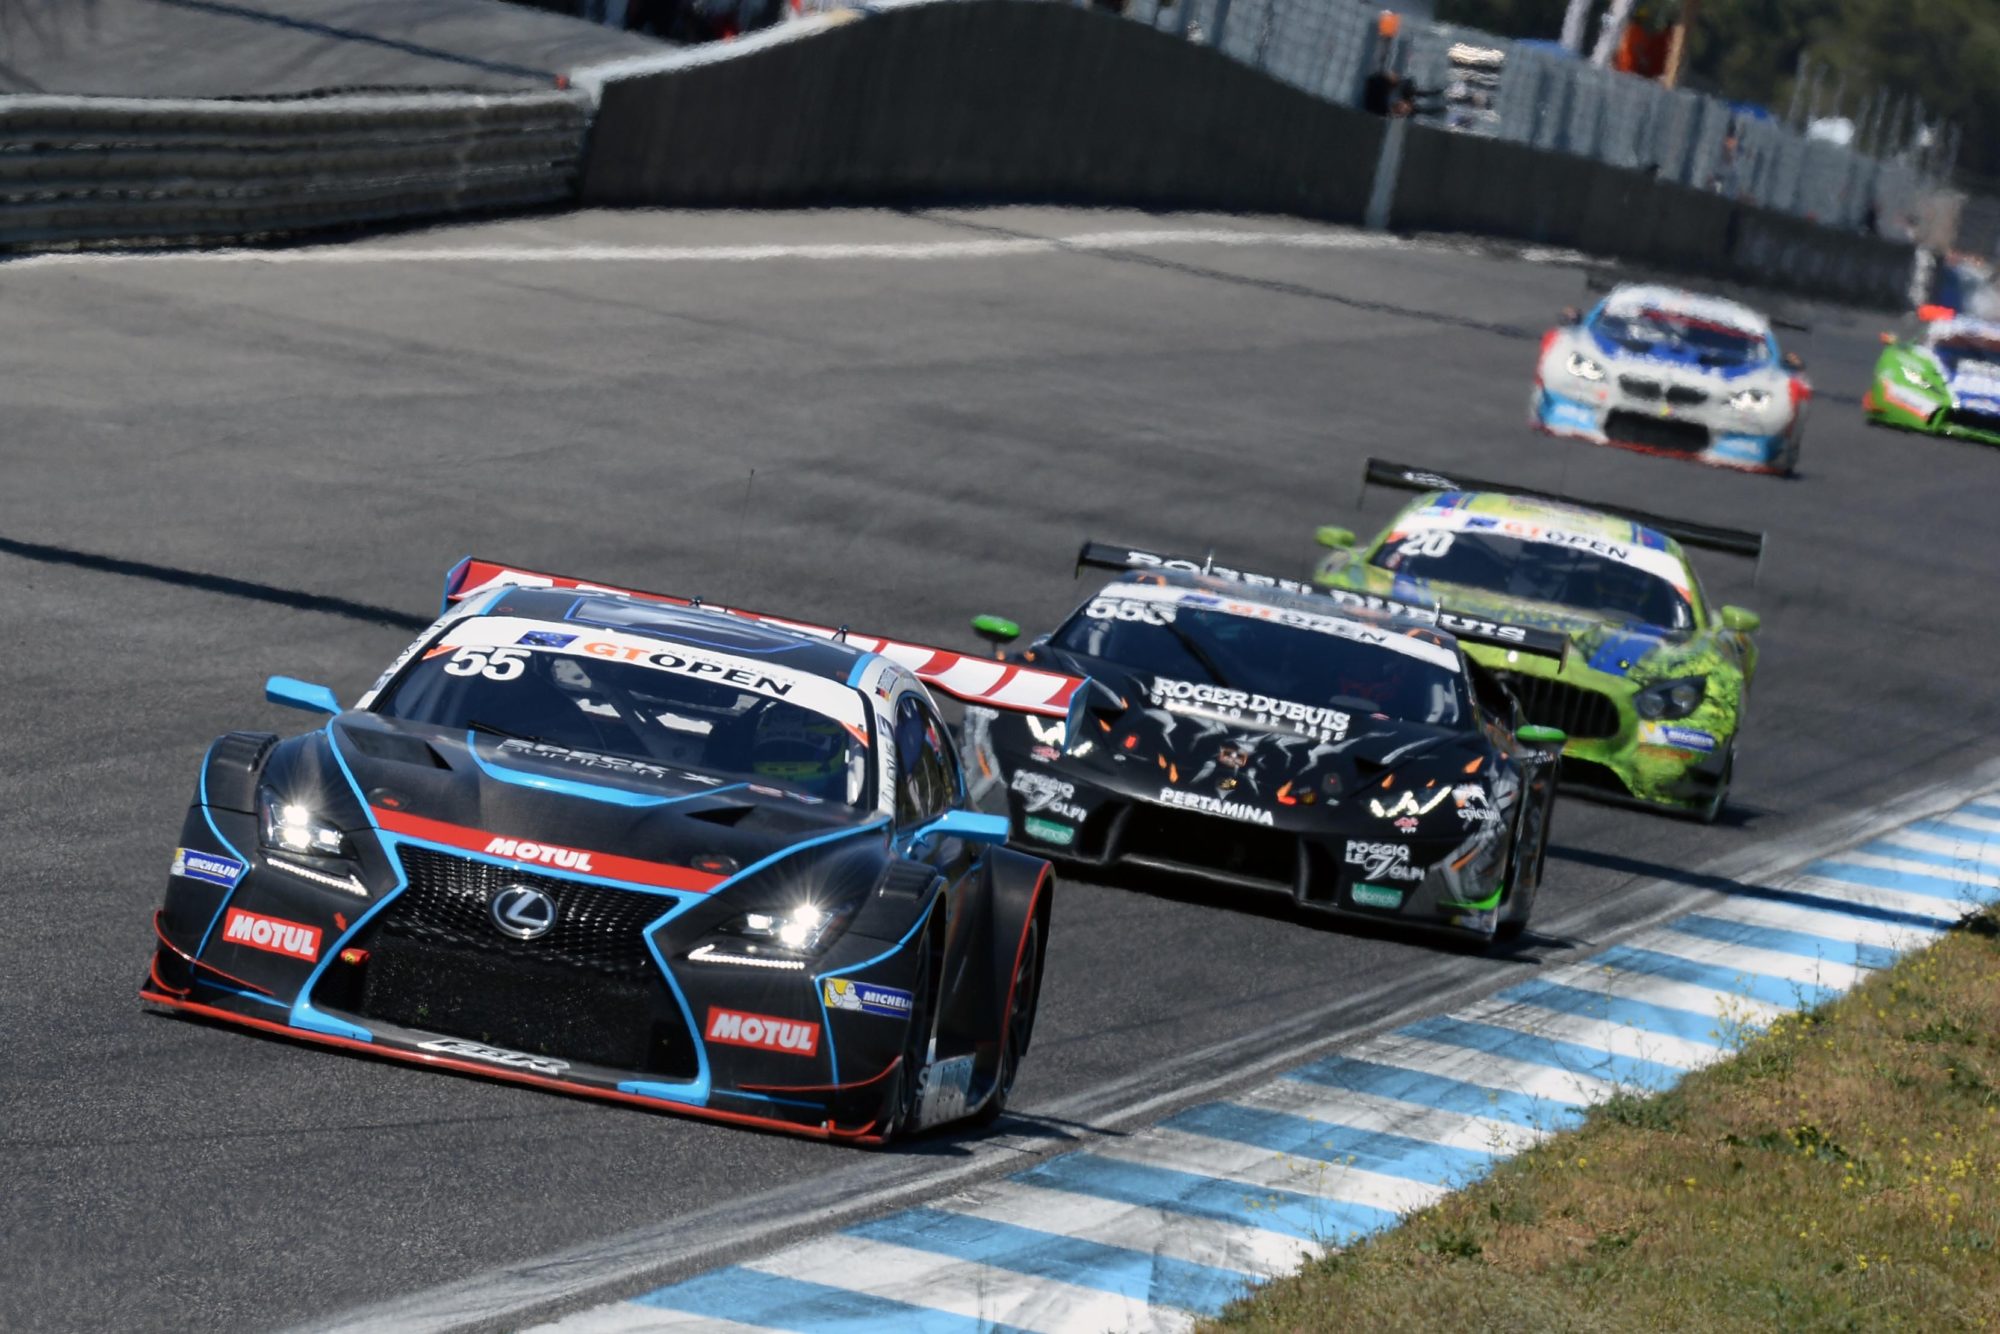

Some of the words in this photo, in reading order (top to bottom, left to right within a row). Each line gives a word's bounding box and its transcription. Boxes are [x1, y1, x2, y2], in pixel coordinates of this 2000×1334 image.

[1399, 530, 1455, 558] 20
[1546, 532, 1628, 560] OPEN
[444, 646, 532, 681] 55
[649, 653, 794, 696] OPEN
[1151, 676, 1249, 709] ROGER
[1250, 694, 1351, 731] DUBUIS
[1159, 786, 1274, 826] PERTAMINA
[187, 857, 240, 879] MICHELIN
[484, 837, 593, 872] MOTUL
[1344, 851, 1366, 865] LE
[228, 913, 315, 955] MOTUL
[711, 1013, 813, 1050] MOTUL
